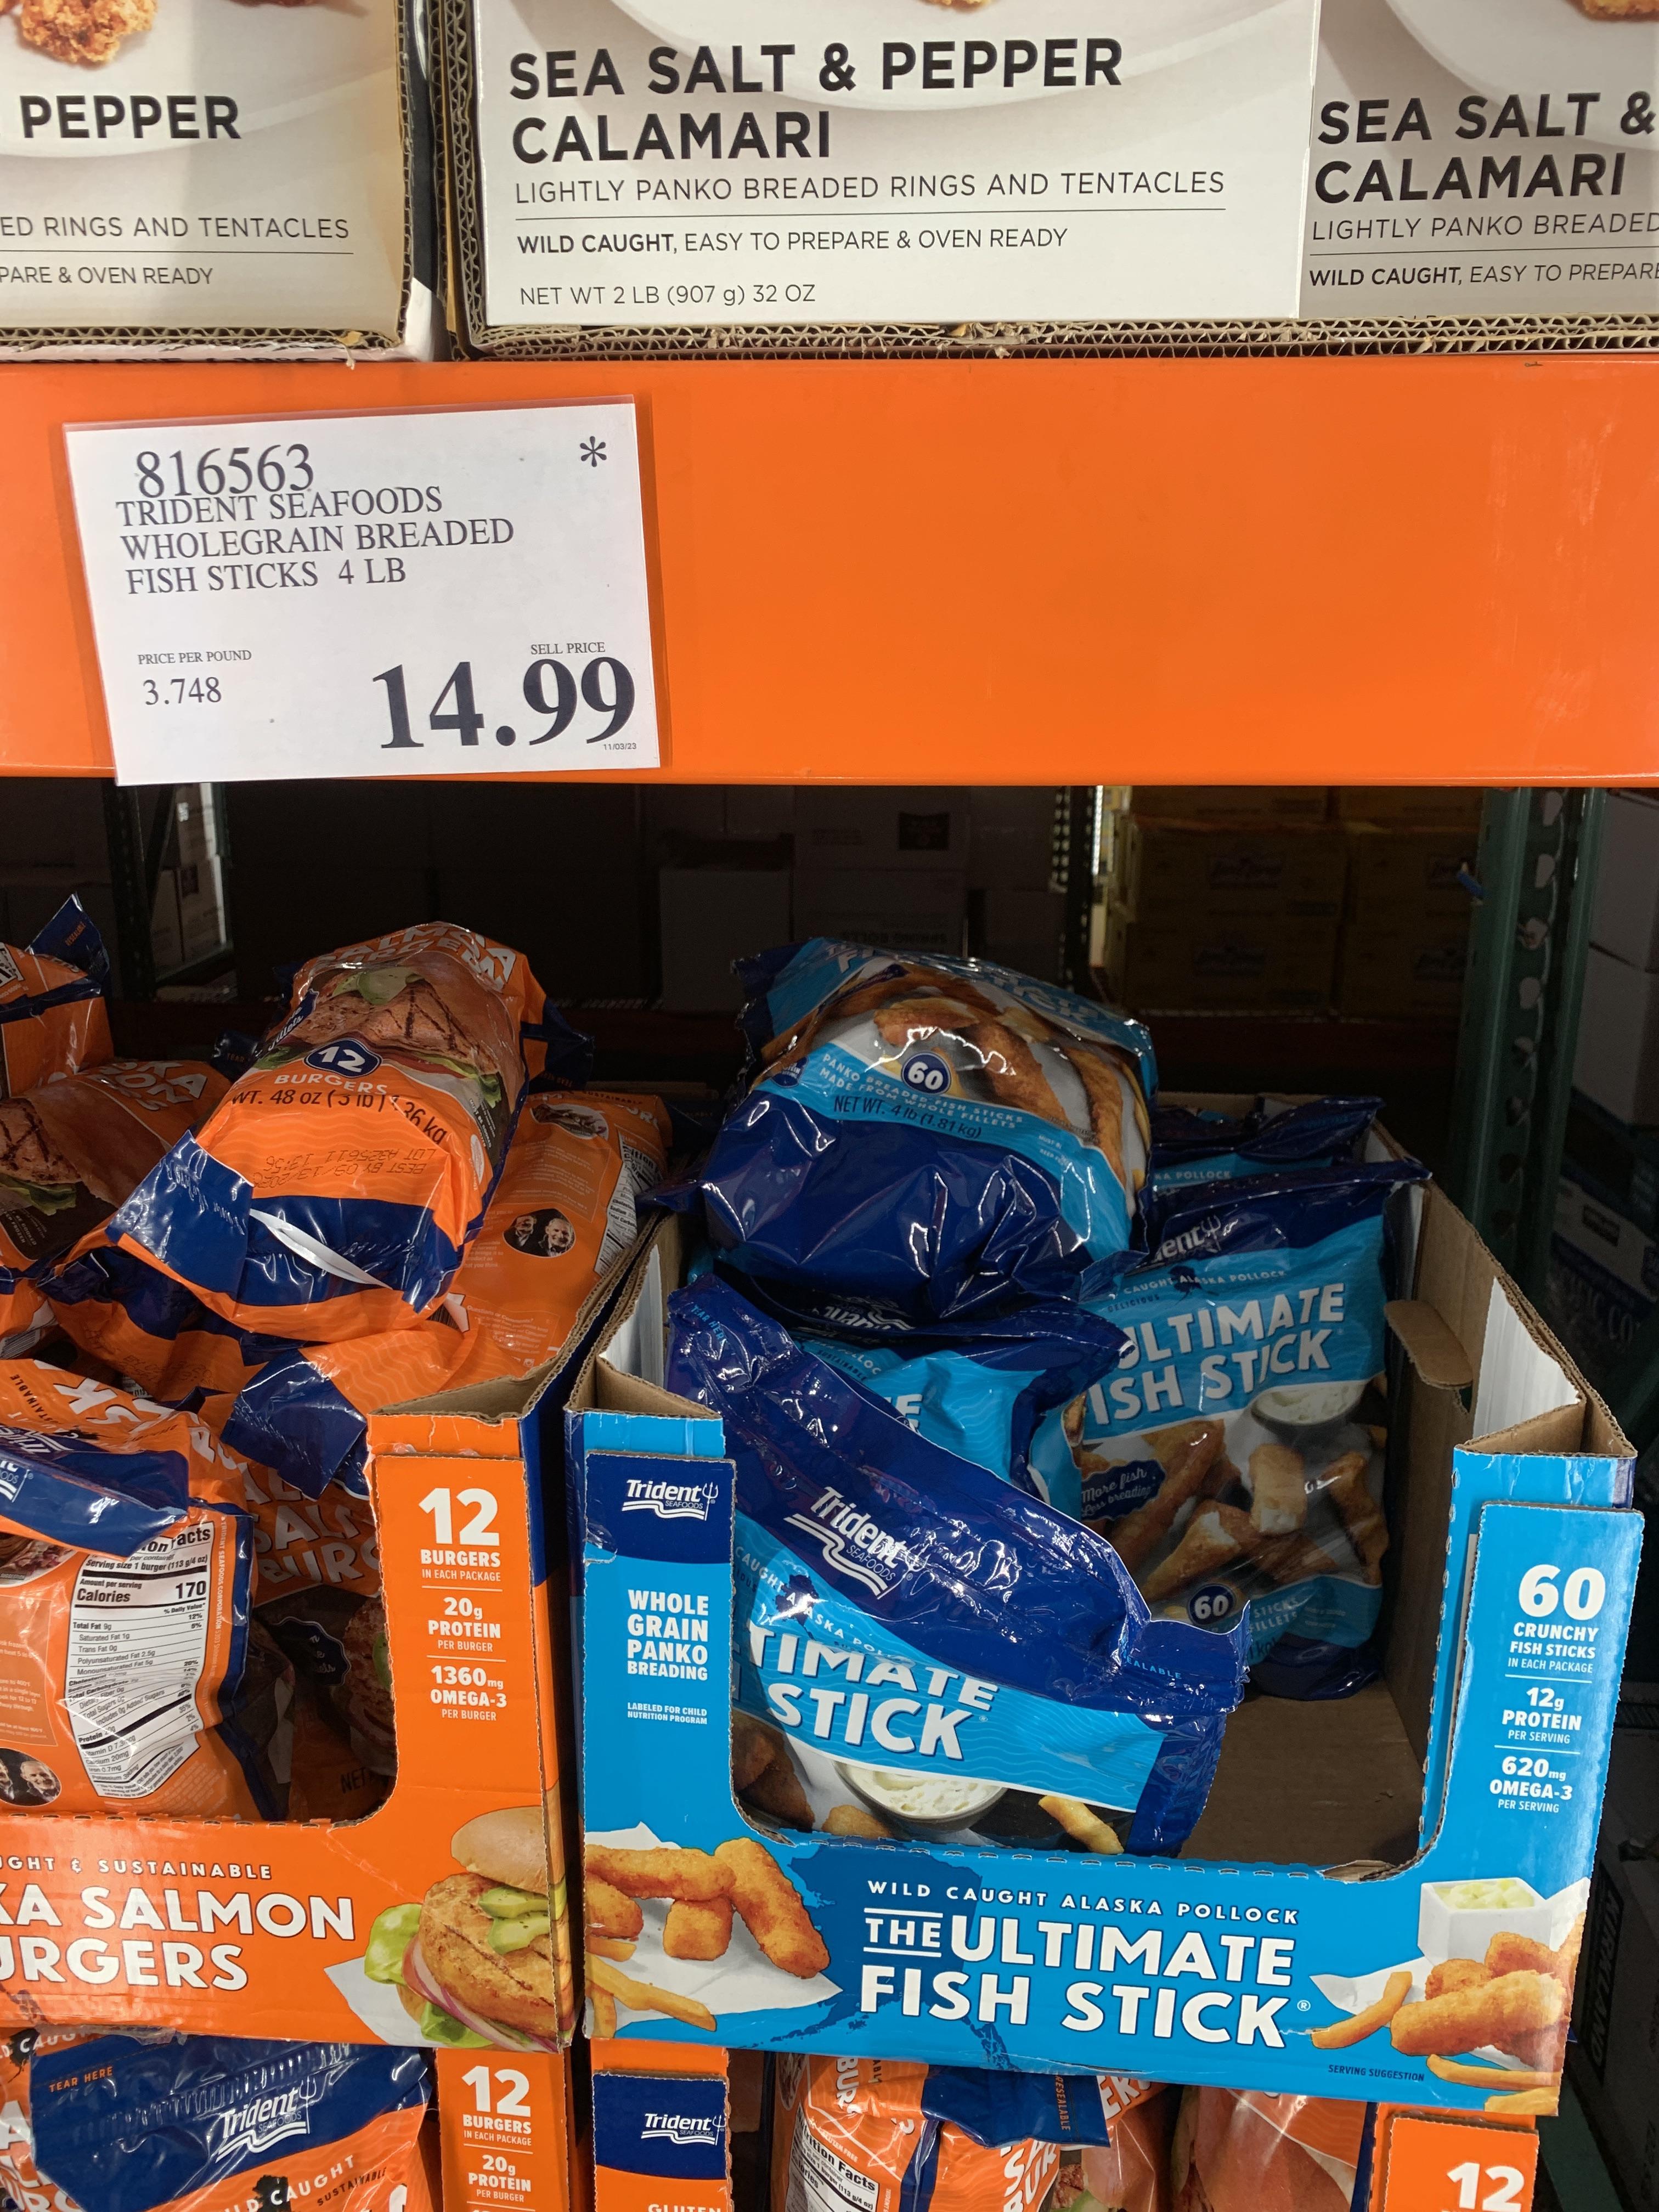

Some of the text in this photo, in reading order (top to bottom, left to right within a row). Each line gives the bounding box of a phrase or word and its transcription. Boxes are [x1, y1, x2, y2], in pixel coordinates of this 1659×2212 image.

[510, 38, 1122, 100] SEA SALT & PEPPER
[20, 95, 241, 139] PEPPER
[1318, 91, 1656, 144] SEA SALT &
[512, 111, 830, 163] CALAMARI
[516, 171, 1224, 204] LIGHTLY PANKO BREADED RINGS AND TENTACLES
[1316, 153, 1626, 204] CALAMARI
[44, 217, 349, 238] RINGS AND TENTACLES
[1313, 218, 1421, 240] LIGHTLY
[1431, 216, 1522, 237] PANKO
[518, 228, 1068, 254] WILD CAUGHT, EASY TO PREPARE & OVEN READY
[59, 267, 213, 284] & OVEN READY
[1309, 264, 1562, 286] WILD CAUGHT, EASY TO
[521, 284, 816, 306] NET WT 2 LB (907 g) 32 OZ
[136, 443, 314, 498] 816563
[116, 486, 443, 526] TRIDENT SEAFOODS
[120, 518, 514, 560] WHOLEGRAIN BREADED
[126, 557, 406, 594] FISH STICKS 4 LB
[138, 650, 252, 664] PRICE PER POUND
[531, 642, 606, 654] SELL PRICE
[143, 677, 222, 705] 3.748
[373, 657, 635, 749] 14.99
[318, 1046, 367, 1073] 12
[274, 1074, 387, 1095] BURGERS
[823, 1053, 1023, 1123] PANKO FISH STICKS
[908, 1062, 944, 1090] 60
[270, 1090, 296, 1104] 48
[820, 1068, 1016, 1128] MADE FROM FILLETS
[834, 1096, 857, 1113] NET
[891, 1105, 901, 1117] 4
[1176, 1170, 1232, 1180] POLLOCK
[1123, 1270, 1286, 1295] CAUGHT POLLOCK
[1200, 1329, 1334, 1400] STICK
[627, 1479, 702, 1502] Trident
[1120, 1467, 1147, 1489] fish
[419, 1487, 500, 1546] 12
[665, 1500, 703, 1509] SEAFOODS
[810, 1487, 909, 1569] Trident
[421, 1549, 500, 1567] BURGERS
[846, 1545, 896, 1582] SEAFOODS
[80, 1579, 104, 1588] Amount
[422, 1569, 500, 1581] IN EACH PACKAGE
[77, 1581, 206, 1602] Calories 170
[628, 1589, 708, 1616] WHOLE
[1519, 1564, 1606, 1621] 60
[443, 1597, 483, 1620] 20g
[1194, 1595, 1229, 1619] 60
[428, 1620, 500, 1638] PROTEIN
[628, 1613, 708, 1642] GRAIN
[1514, 1622, 1599, 1642] CRUNCHY
[438, 1640, 493, 1652] PER BURGER
[628, 1639, 708, 1665] PANKO
[1510, 1641, 1596, 1659] FISH STICKS
[431, 1665, 504, 1690] 1360mg
[628, 1661, 708, 1681] BREADING
[1508, 1657, 1593, 1673] IN EACH PACKAGE
[430, 1689, 507, 1708] OMEGA-3
[628, 1702, 707, 1717] LABELED FOR CHILD
[1526, 1687, 1564, 1711] 12g
[442, 1709, 496, 1721] PER BURGER
[628, 1711, 708, 1724] NUTRITION PROGRAM
[768, 1683, 974, 1760] STICK
[1502, 1709, 1582, 1730] PROTEIN
[1508, 1730, 1570, 1744] PER SERVING
[1502, 1756, 1566, 1781] 620mg
[1489, 1779, 1573, 1800] OMEGA-3
[1498, 1799, 1559, 1813] PER SERVING
[99, 1859, 272, 1880] SUSTAINABLE
[80, 1886, 356, 1940] SALMON
[868, 1880, 1298, 1925] WILD CAUGHT ALASKA POLLOCK
[865, 1914, 1295, 1986] THE ULTIMATE
[861, 1965, 1030, 2025] FISH
[49, 2067, 114, 2092] TEAR HERE
[1329, 2064, 1425, 2081] SERVING SUGGESTION
[461, 2066, 531, 2117] 12
[1056, 2075, 1071, 2131] RESEALABLE
[220, 2086, 298, 2138] Trident
[462, 2114, 532, 2135] BURGERS
[645, 2113, 712, 2131] Trident
[271, 2154, 354, 2205] CAUGHT
[838, 2159, 876, 2191] Facts
[1447, 2162, 1525, 2212] 12
